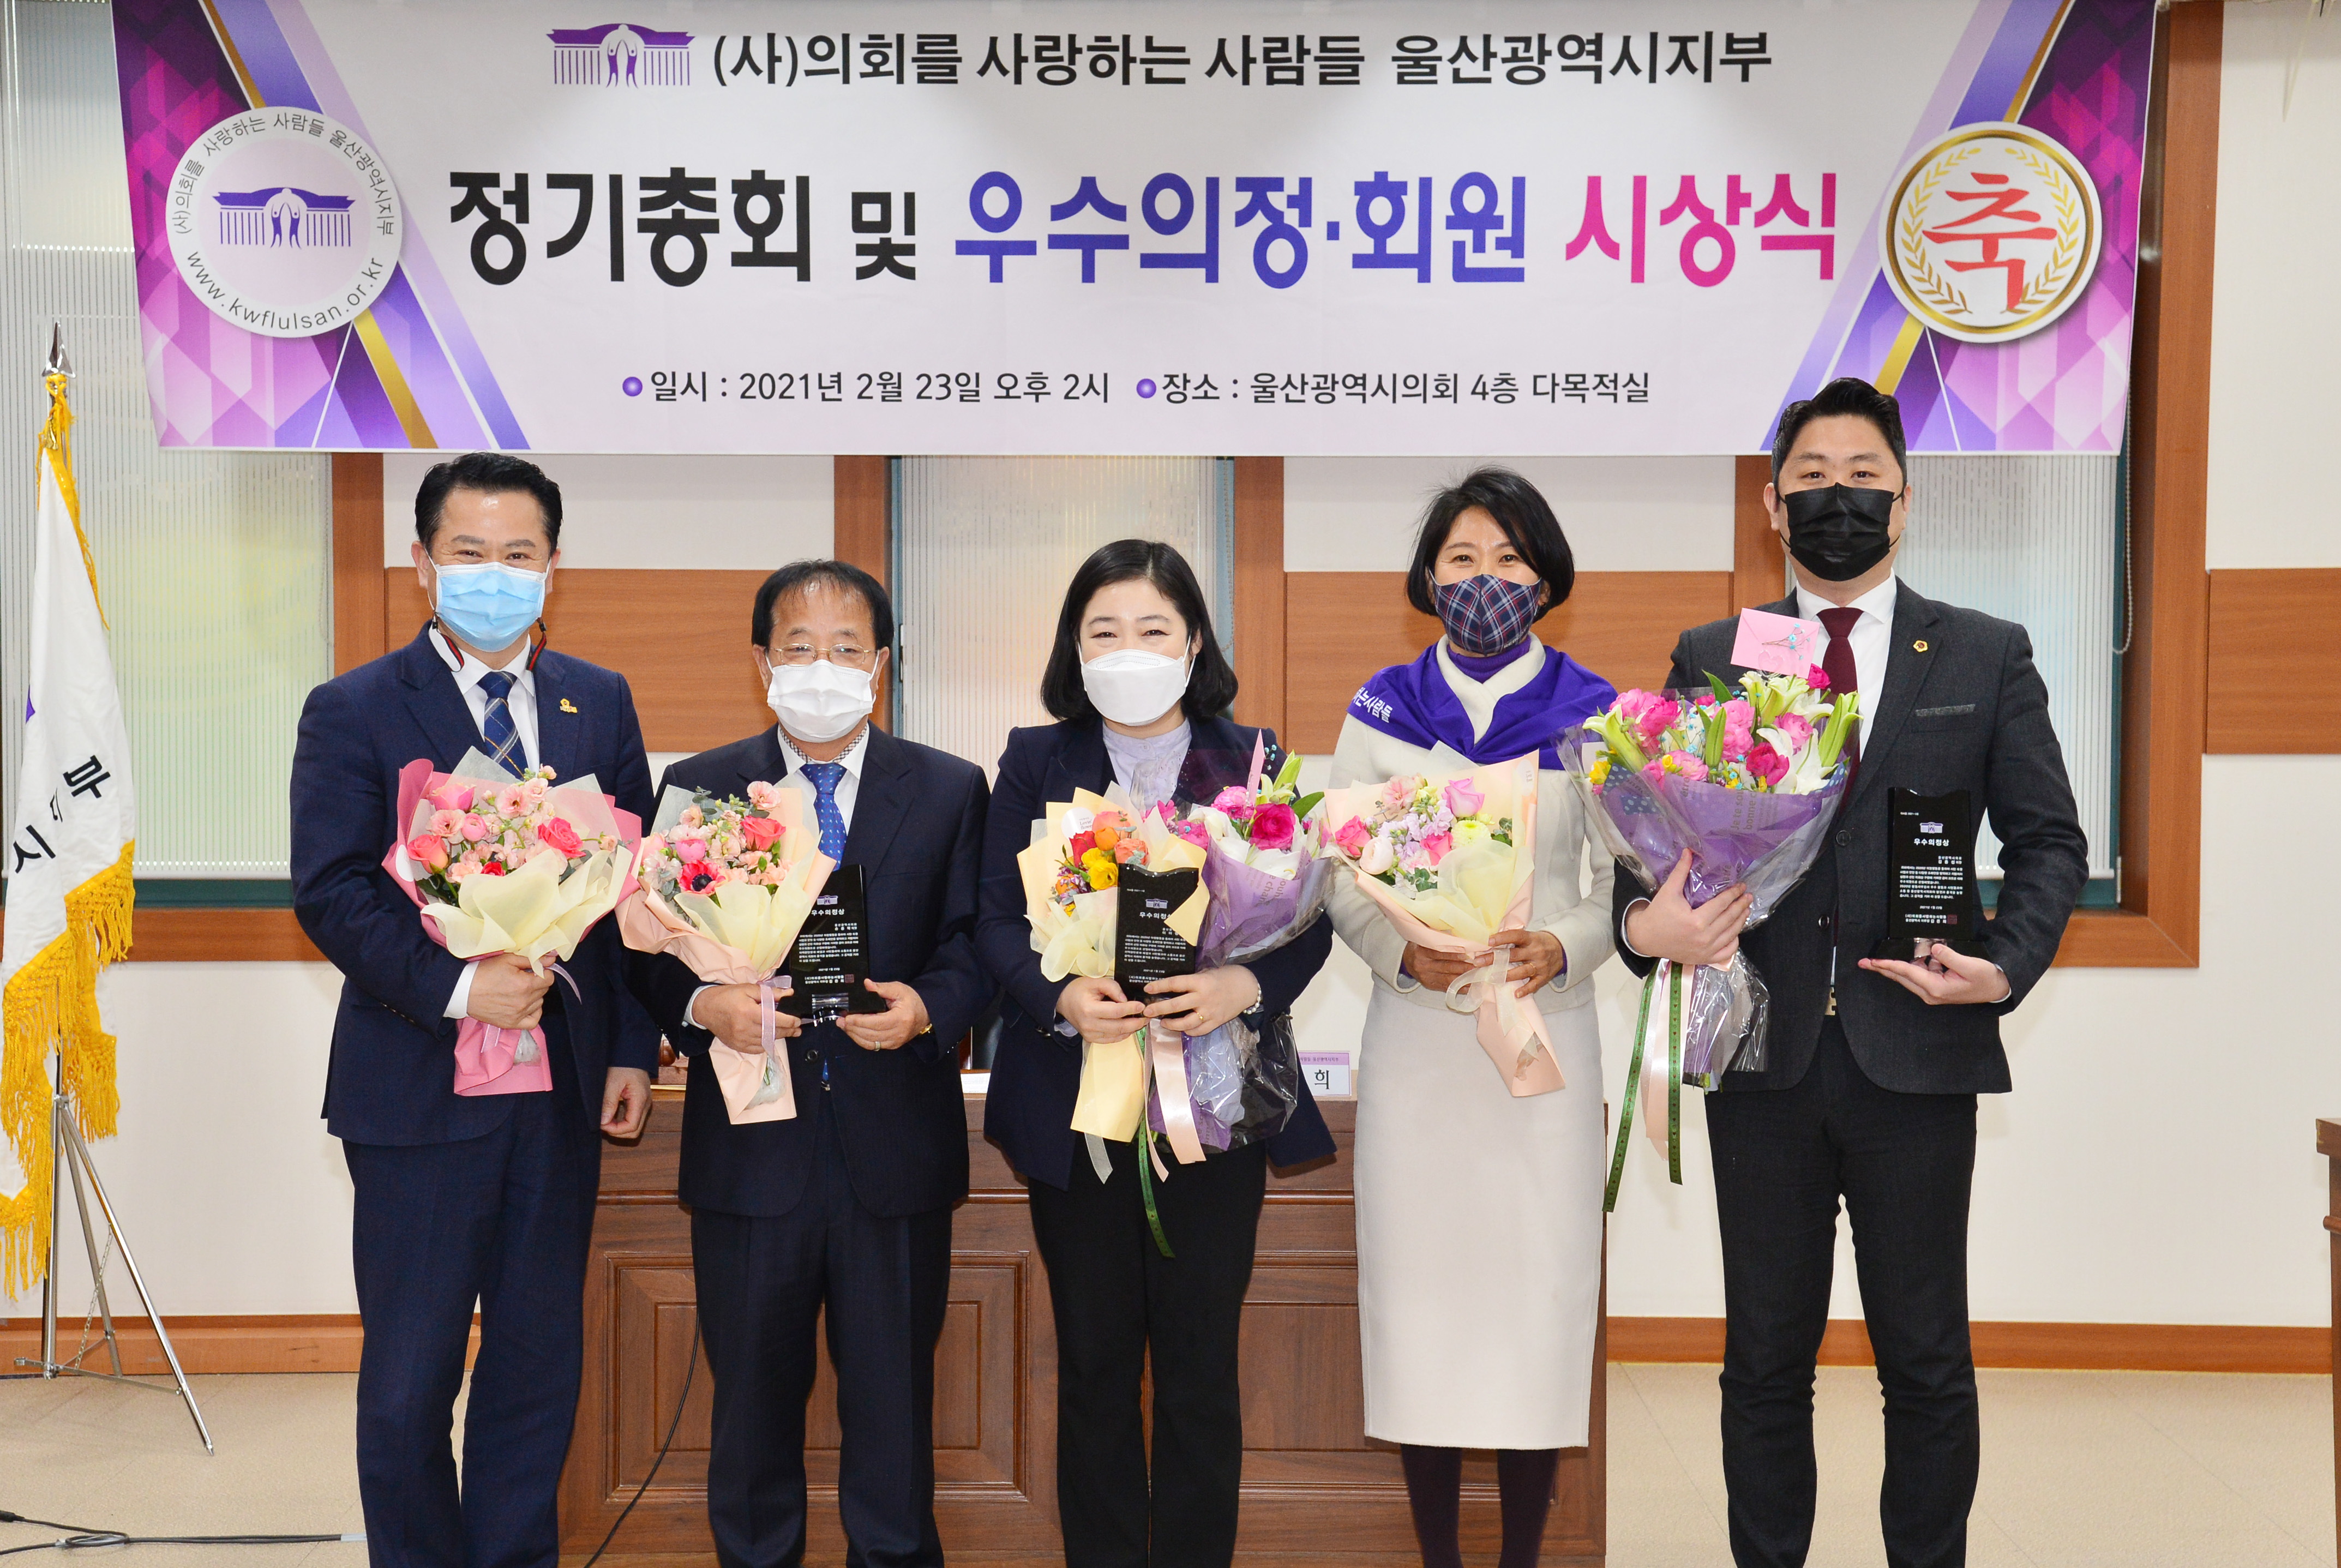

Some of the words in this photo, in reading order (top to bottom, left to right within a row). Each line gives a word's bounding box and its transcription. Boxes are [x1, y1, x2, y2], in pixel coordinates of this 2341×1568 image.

[714, 33, 963, 88] (사)의회를
[976, 33, 1191, 87] 사랑하는
[1204, 34, 1366, 87] 사람들
[1391, 31, 1773, 86] 울산광역시지부
[172, 159, 205, 235] (사)의회를
[203, 115, 266, 158] 사랑하는
[273, 112, 325, 137] 사람들
[329, 129, 395, 236] 울산광역시지부
[450, 167, 811, 288] 정기총회
[851, 191, 916, 281] 및
[1565, 173, 1837, 288] 시상식
[1922, 172, 2057, 310] 축
[187, 251, 385, 330] www.kwflulsan.or.kr
[651, 371, 707, 402] 일시
[740, 372, 843, 402] 2021년
[857, 372, 903, 403] 2월
[916, 373, 981, 403] 23일
[994, 373, 1052, 404] 오후
[1064, 373, 1109, 404] 2시
[1162, 373, 1221, 405] 장소
[1250, 373, 1459, 405] 울산광역시의회
[1470, 373, 1520, 405] 4층
[1533, 373, 1649, 404] 다목적실
[1913, 838, 1949, 846] 우수의정상
[811, 908, 845, 916] 우수의정상
[1314, 1069, 1329, 1090] 희
